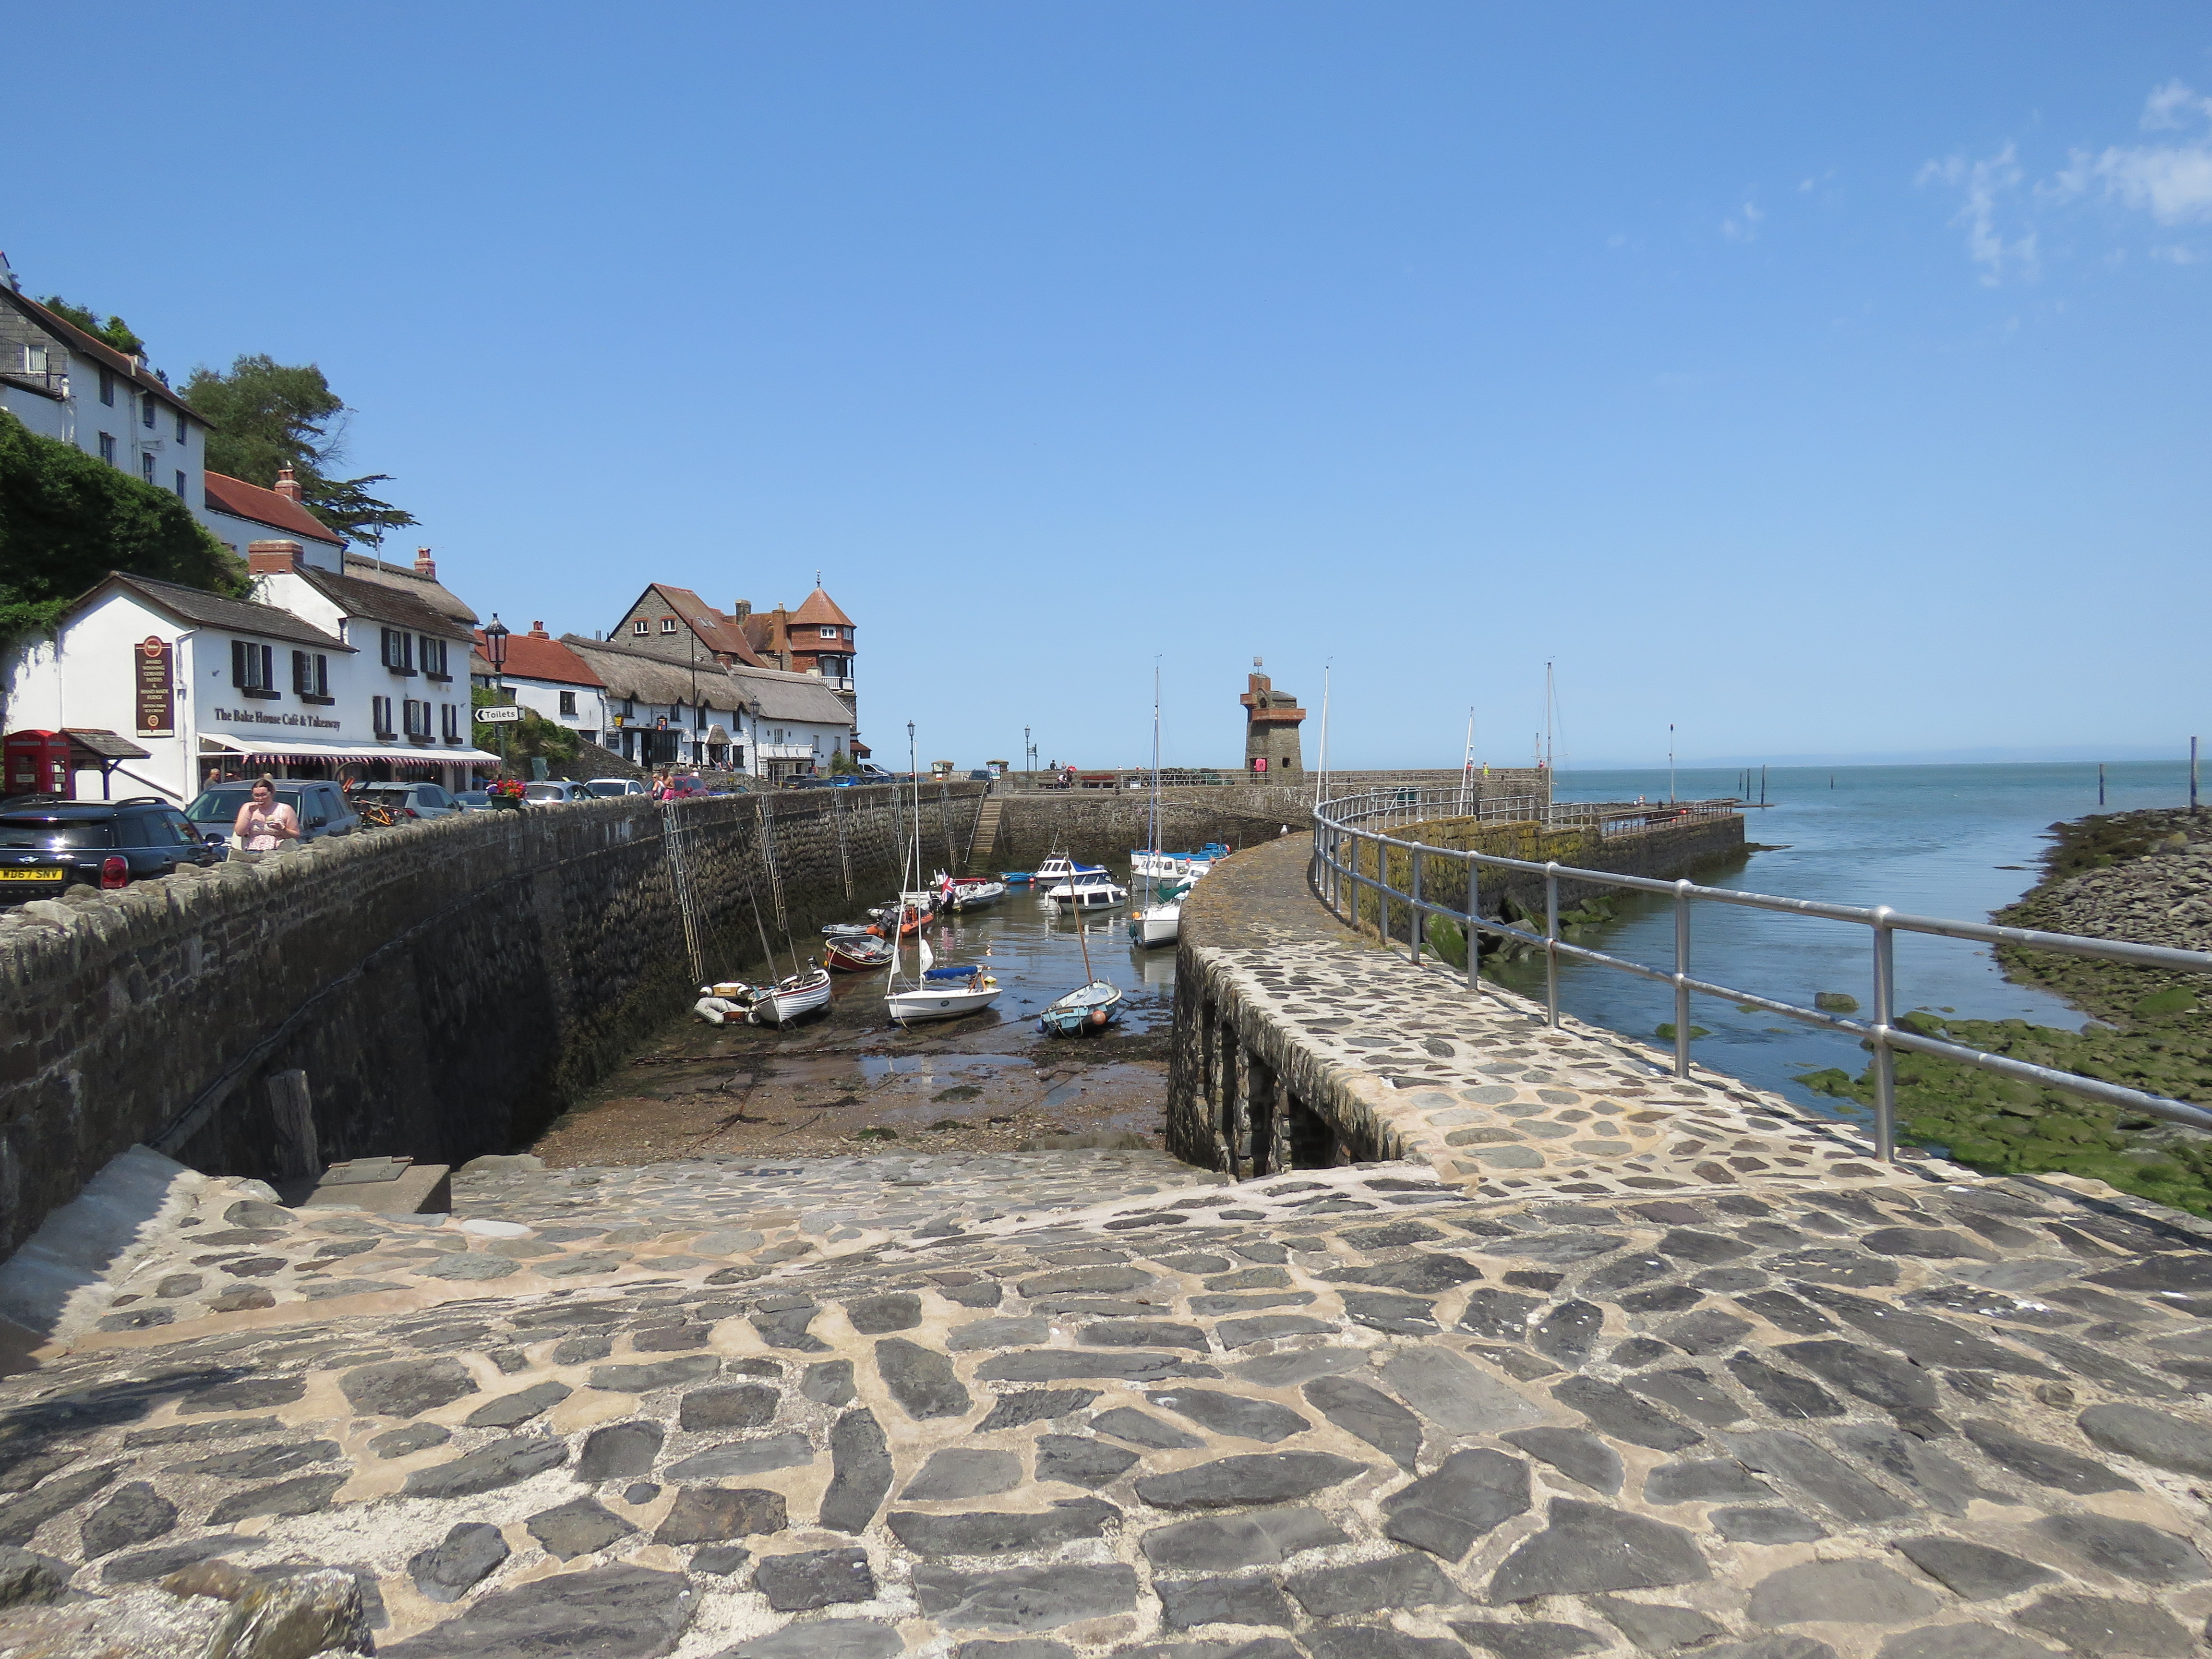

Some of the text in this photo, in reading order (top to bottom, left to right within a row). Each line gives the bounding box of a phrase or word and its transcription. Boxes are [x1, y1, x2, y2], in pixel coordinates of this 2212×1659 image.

[215, 708, 231, 721] The
[233, 709, 254, 722] Bake
[255, 711, 281, 724] House
[300, 715, 307, 726] &
[307, 715, 341, 732] Takeaway
[3, 869, 32, 878] WD67
